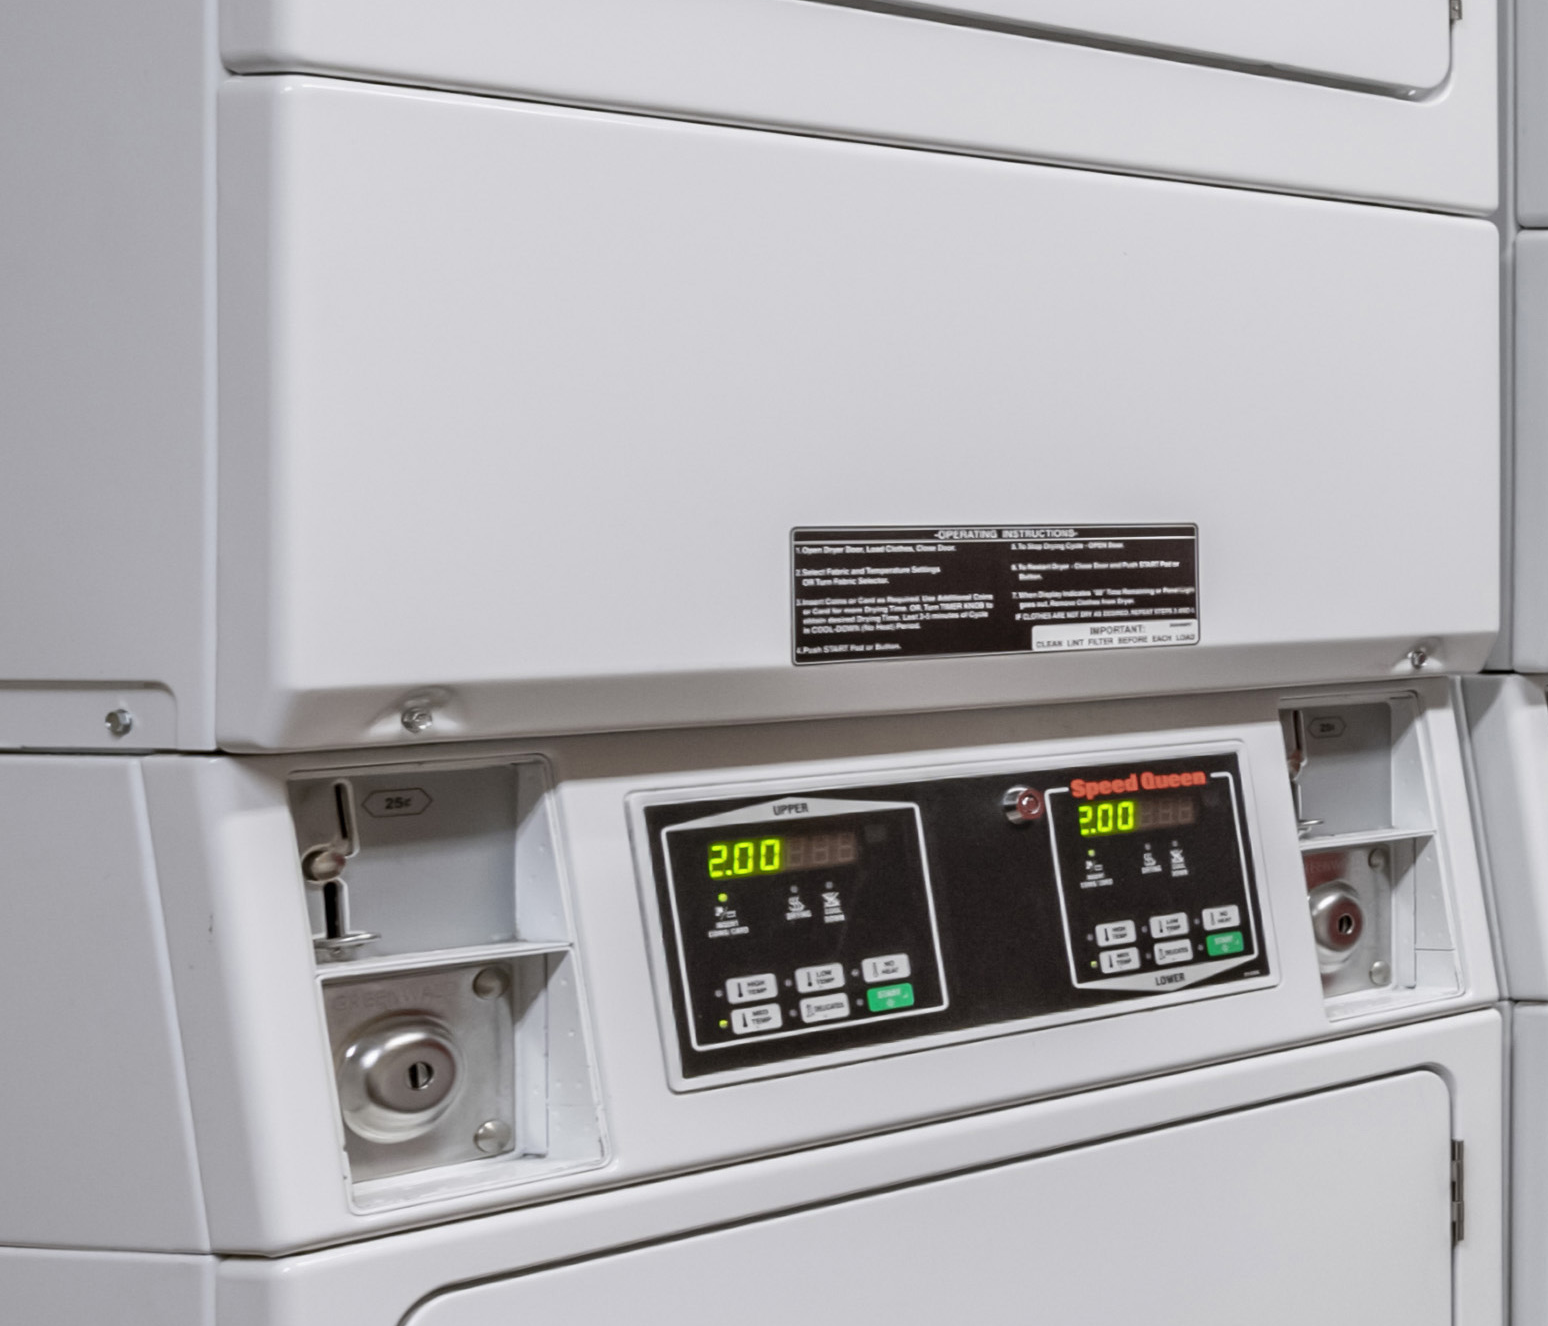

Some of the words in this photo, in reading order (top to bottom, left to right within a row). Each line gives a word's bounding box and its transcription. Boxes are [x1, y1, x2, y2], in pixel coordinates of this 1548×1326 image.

[1070, 773, 1139, 800] Speed
[1140, 771, 1207, 791] Queen
[773, 802, 809, 816] UPPER
[1155, 972, 1185, 986] LOWER
